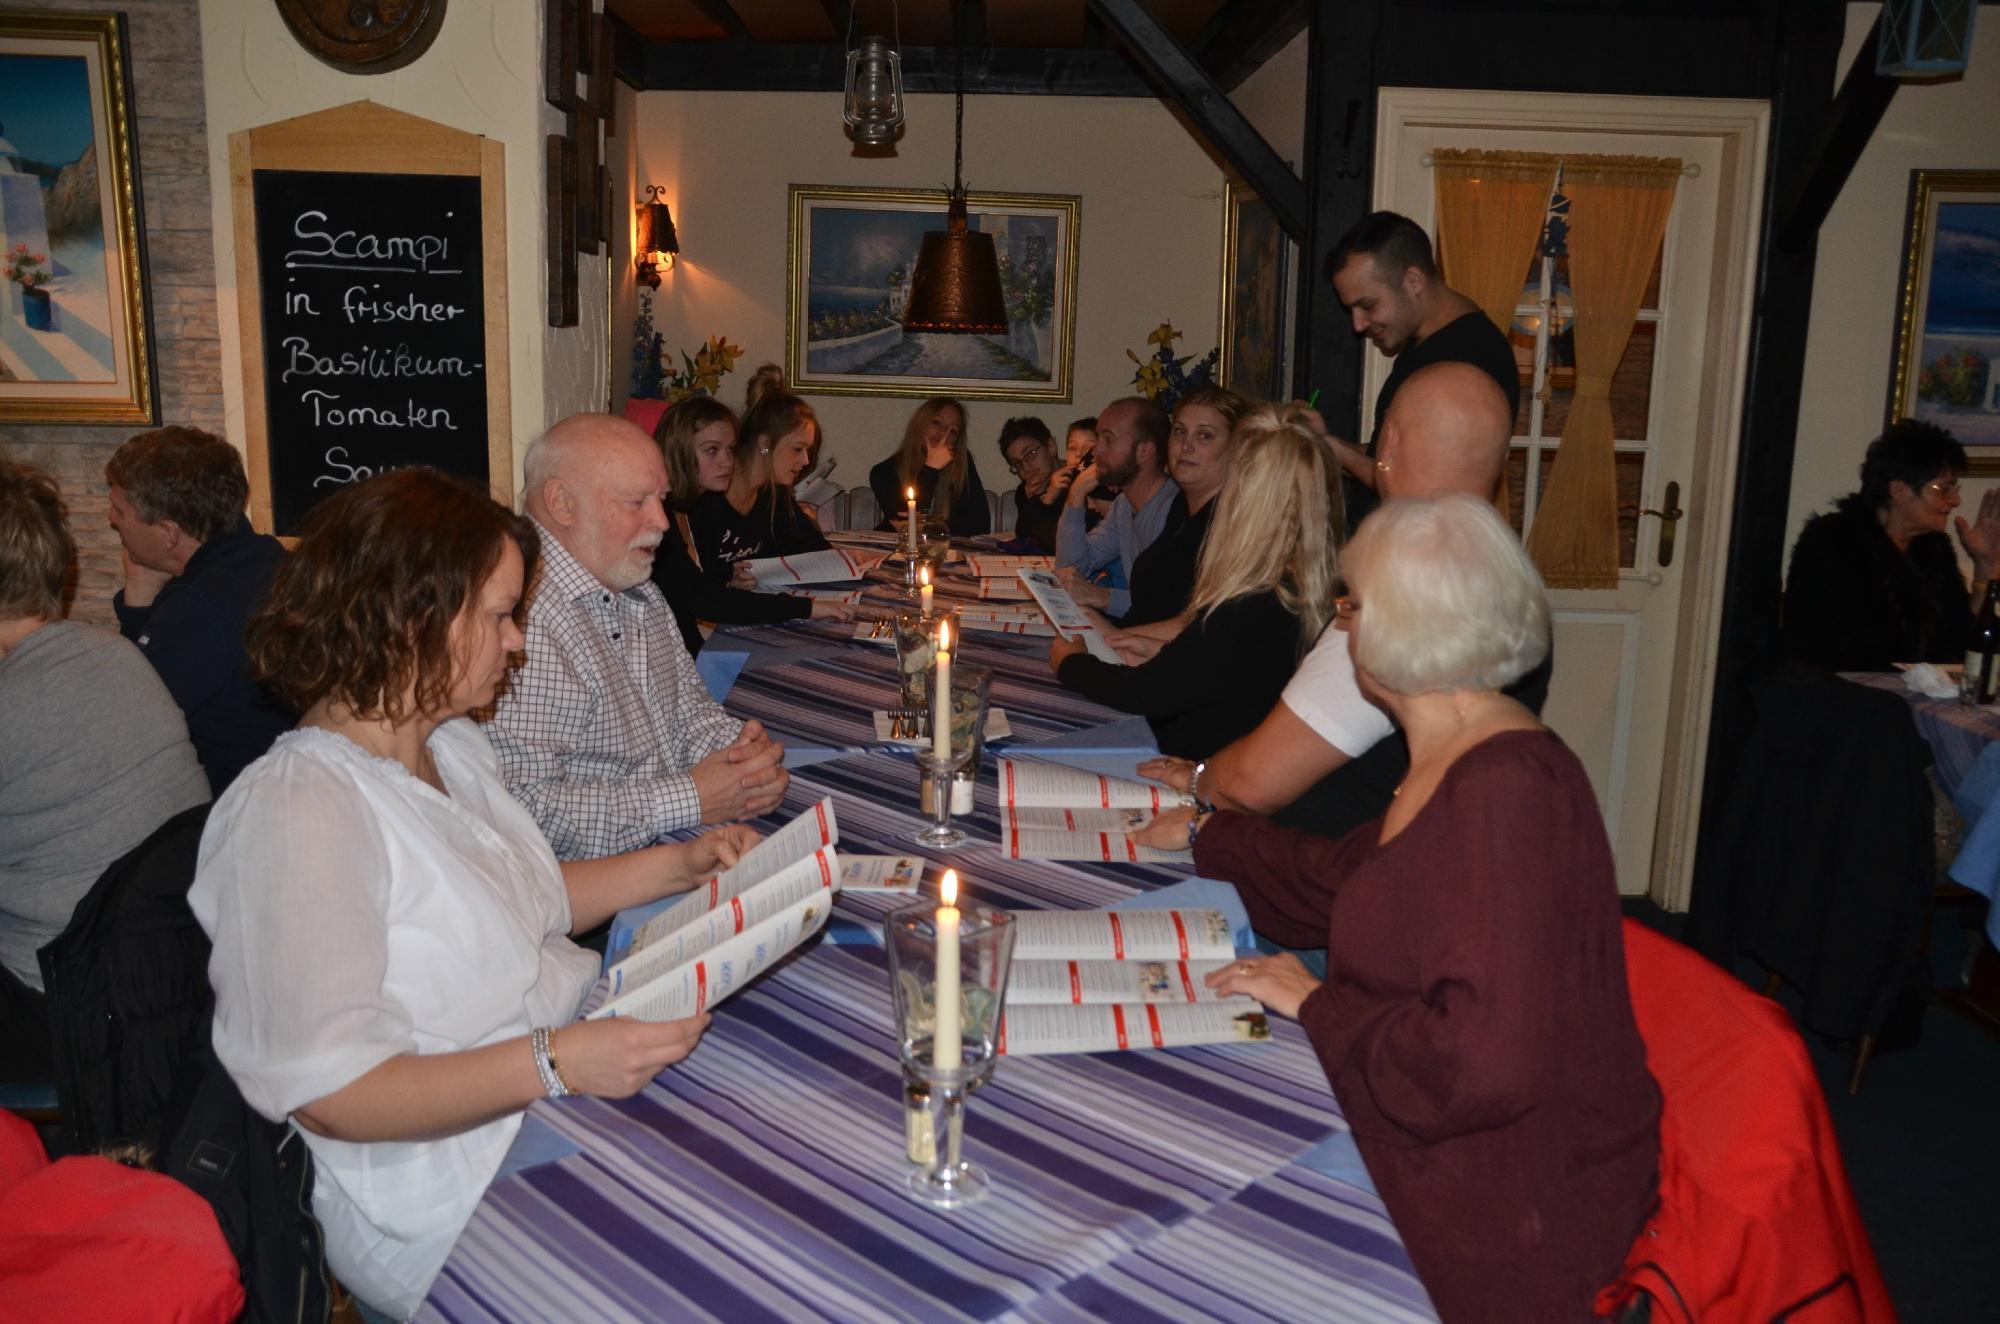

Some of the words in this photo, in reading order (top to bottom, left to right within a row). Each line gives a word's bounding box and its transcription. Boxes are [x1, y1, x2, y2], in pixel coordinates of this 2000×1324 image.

[285, 211, 450, 272] Scampi
[286, 277, 320, 316] in
[343, 284, 465, 323] frischer
[282, 337, 483, 383] Basilikum-
[302, 390, 458, 429] Tomaten
